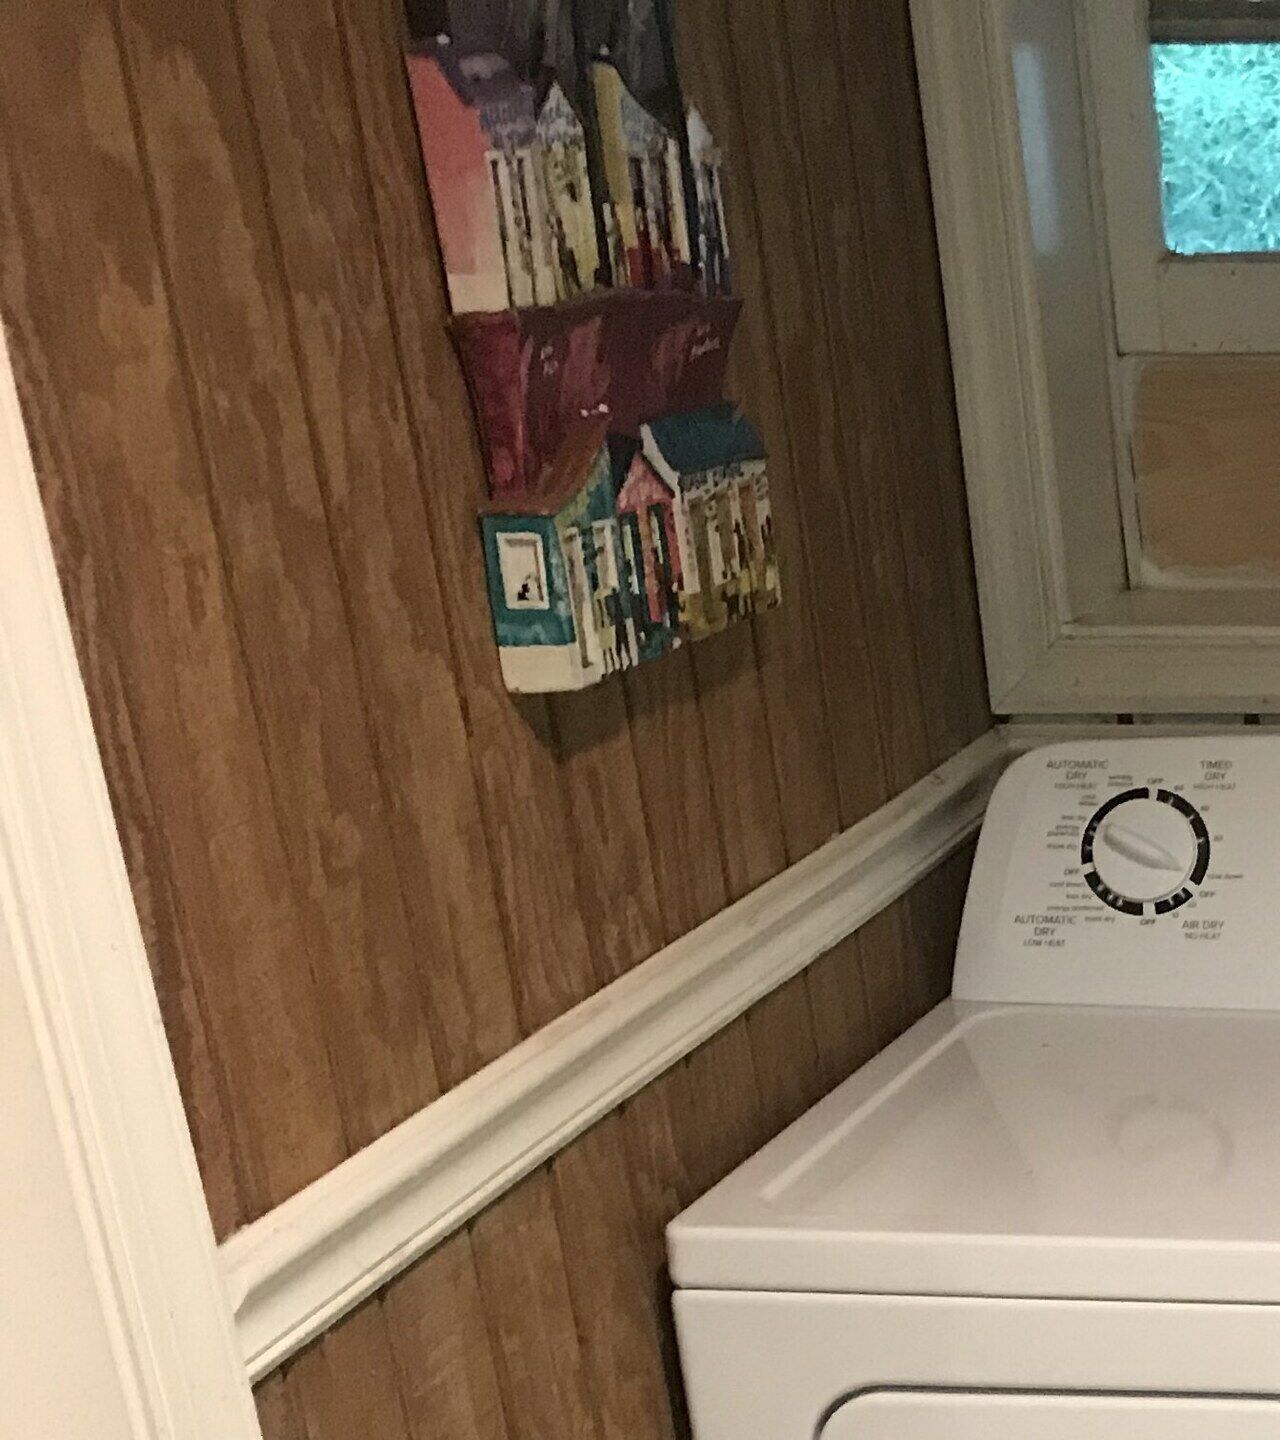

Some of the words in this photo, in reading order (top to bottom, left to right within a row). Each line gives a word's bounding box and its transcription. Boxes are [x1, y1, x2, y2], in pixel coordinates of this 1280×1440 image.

[1046, 759, 1109, 770] AUTOMATIC
[1200, 759, 1232, 770] TIMED
[1065, 770, 1088, 781] DRY
[1204, 770, 1227, 781] DRY
[1014, 914, 1077, 925] AUTOMATIC
[1182, 920, 1200, 930] AIR
[1202, 920, 1224, 930] DRY
[1034, 926, 1056, 937] DRY
